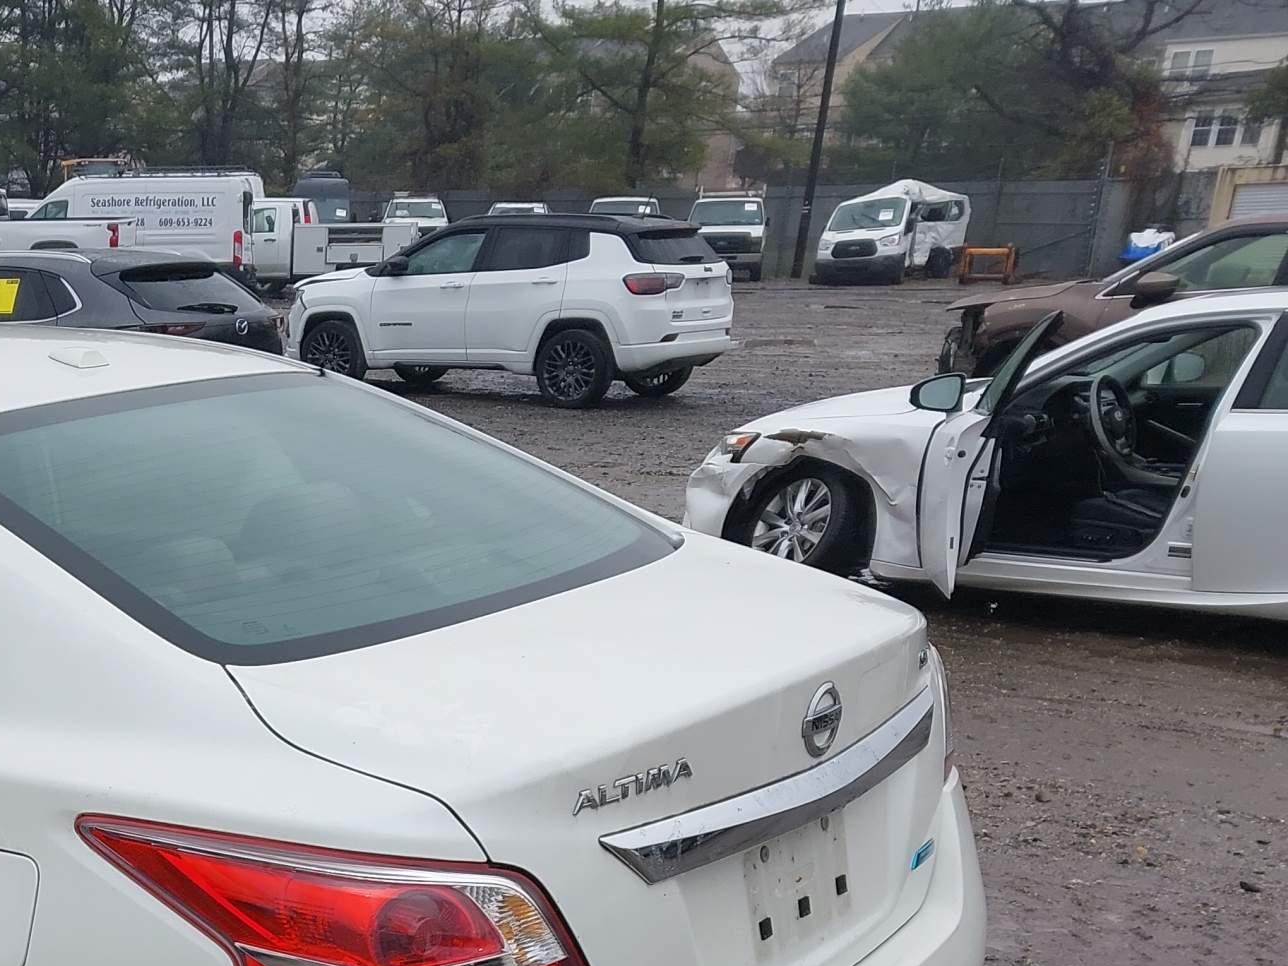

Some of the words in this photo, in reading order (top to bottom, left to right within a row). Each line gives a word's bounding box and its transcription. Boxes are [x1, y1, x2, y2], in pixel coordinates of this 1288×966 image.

[90, 196, 131, 208] Seashore
[134, 196, 198, 209] Refrigeration,
[201, 196, 217, 207] LLC
[158, 217, 213, 227] 609-653-9224
[572, 757, 693, 817] ALTIMA
